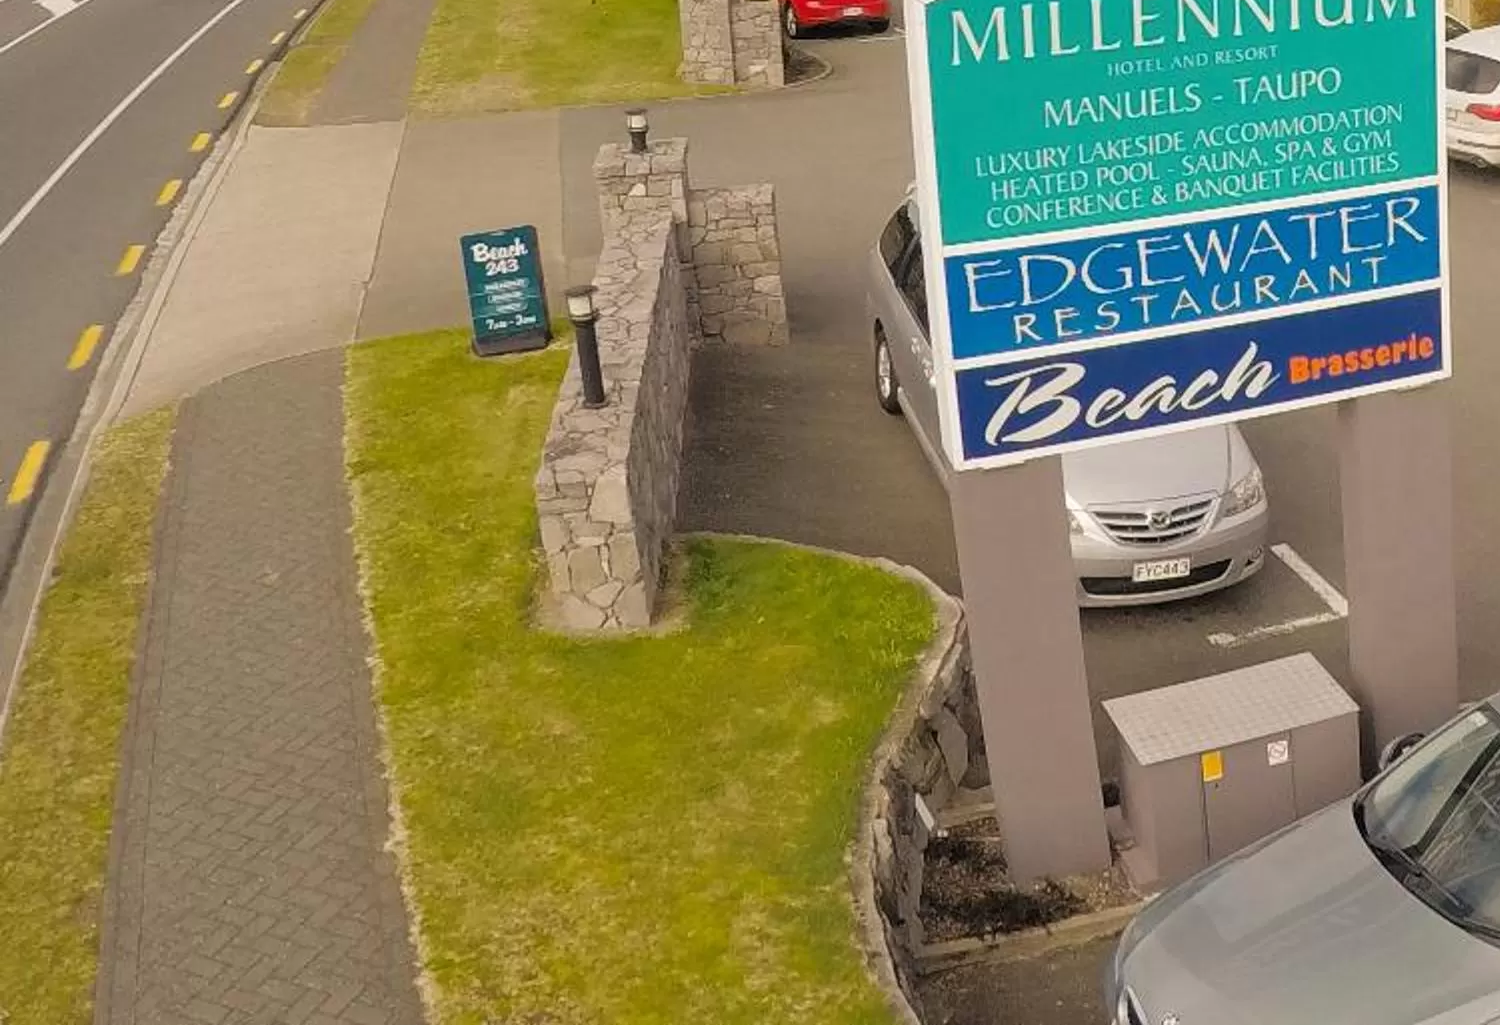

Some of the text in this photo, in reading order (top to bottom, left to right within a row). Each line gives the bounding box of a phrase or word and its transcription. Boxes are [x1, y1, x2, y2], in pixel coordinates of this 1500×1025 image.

[1044, 83, 1201, 128] MANUELS
[1233, 66, 1342, 105] TAUPO
[1107, 44, 1279, 77] HOTEL AND RESORT
[975, 104, 1403, 177] LUXURY LAKESIDE ACCOMMODATION
[991, 170, 1089, 202] HEATED
[1096, 160, 1160, 189] POOL
[1275, 139, 1317, 163] SPA
[1321, 136, 1338, 157] &
[1343, 129, 1393, 154] GYM
[987, 151, 1400, 229] CONFERENCE & BANQUET FACILITIES
[470, 237, 529, 262] Beach
[485, 258, 520, 277] 243
[965, 196, 1428, 313] EDGEWATER
[1015, 255, 1387, 345] RESTAURANT
[985, 332, 1434, 447] Beach Brasserie
